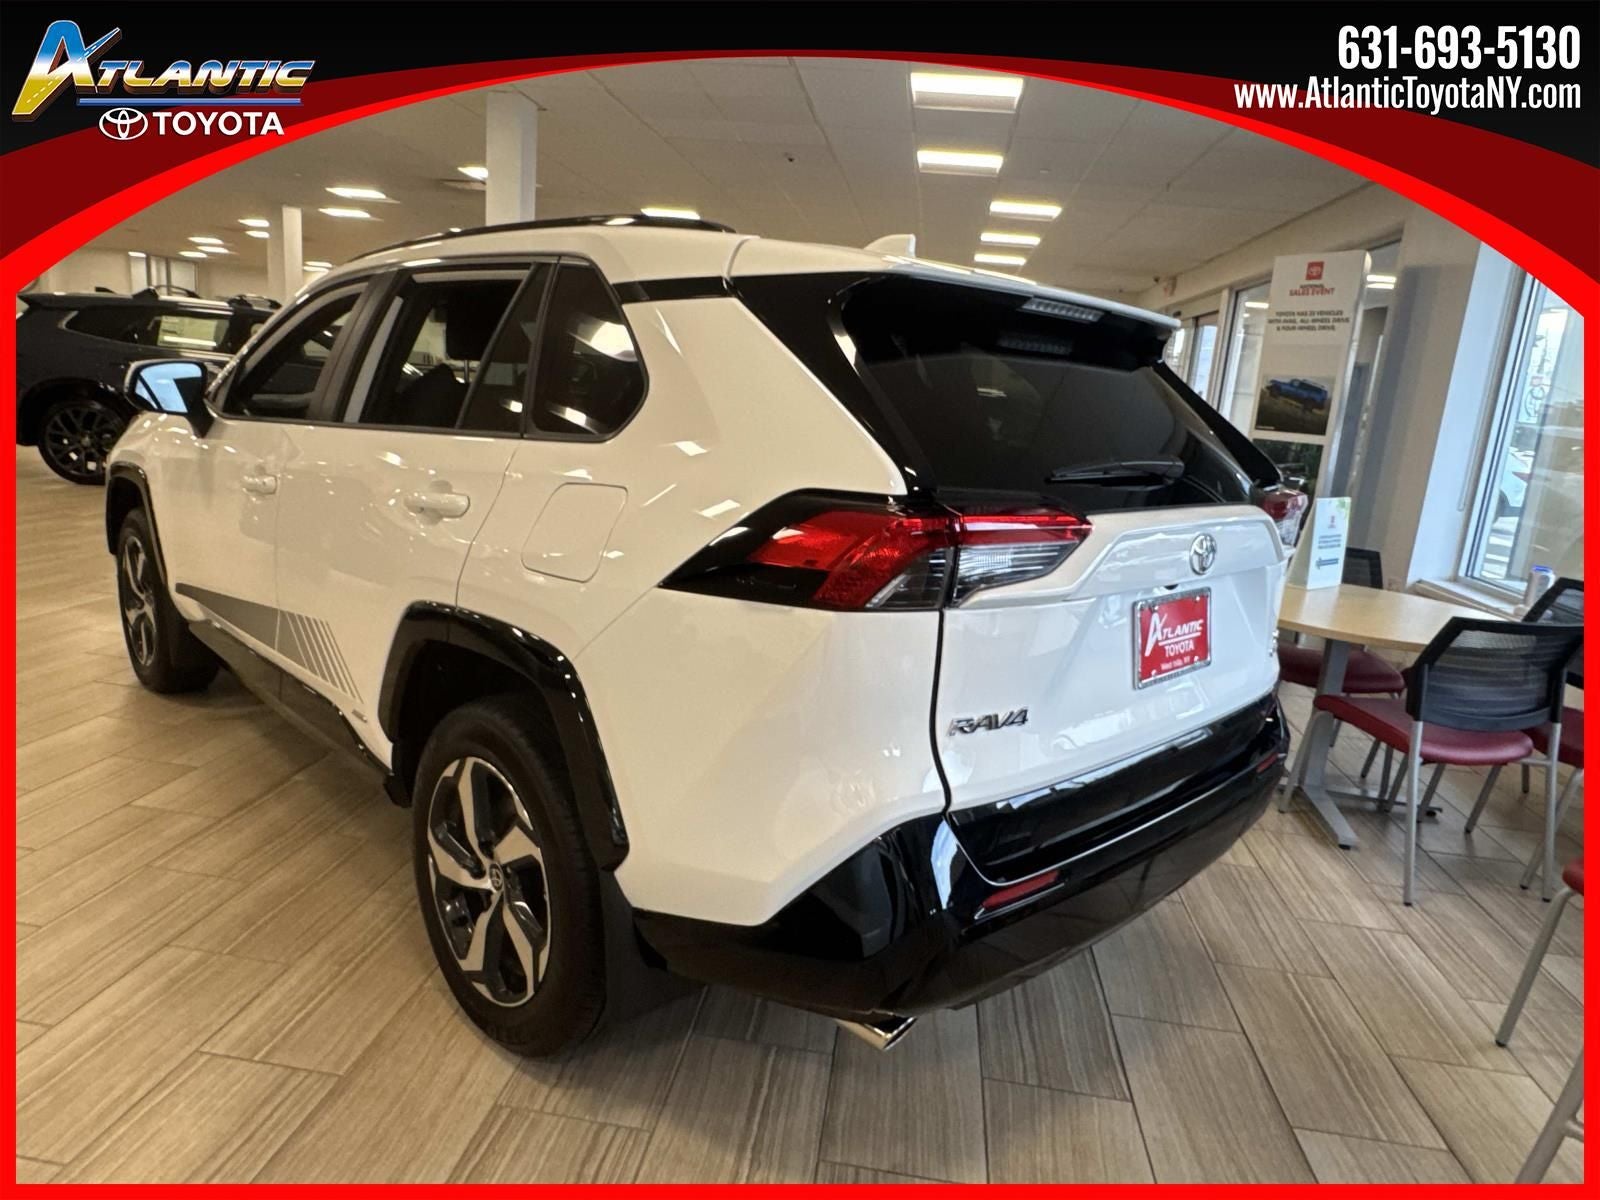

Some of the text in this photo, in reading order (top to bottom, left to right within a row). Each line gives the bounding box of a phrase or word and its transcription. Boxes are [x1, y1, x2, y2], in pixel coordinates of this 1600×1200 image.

[1289, 287, 1335, 297] SALES EVENT
[1145, 612, 1204, 657] ATLANTIC
[1164, 639, 1195, 658] TOYOTA
[946, 705, 1029, 737] RAV4
